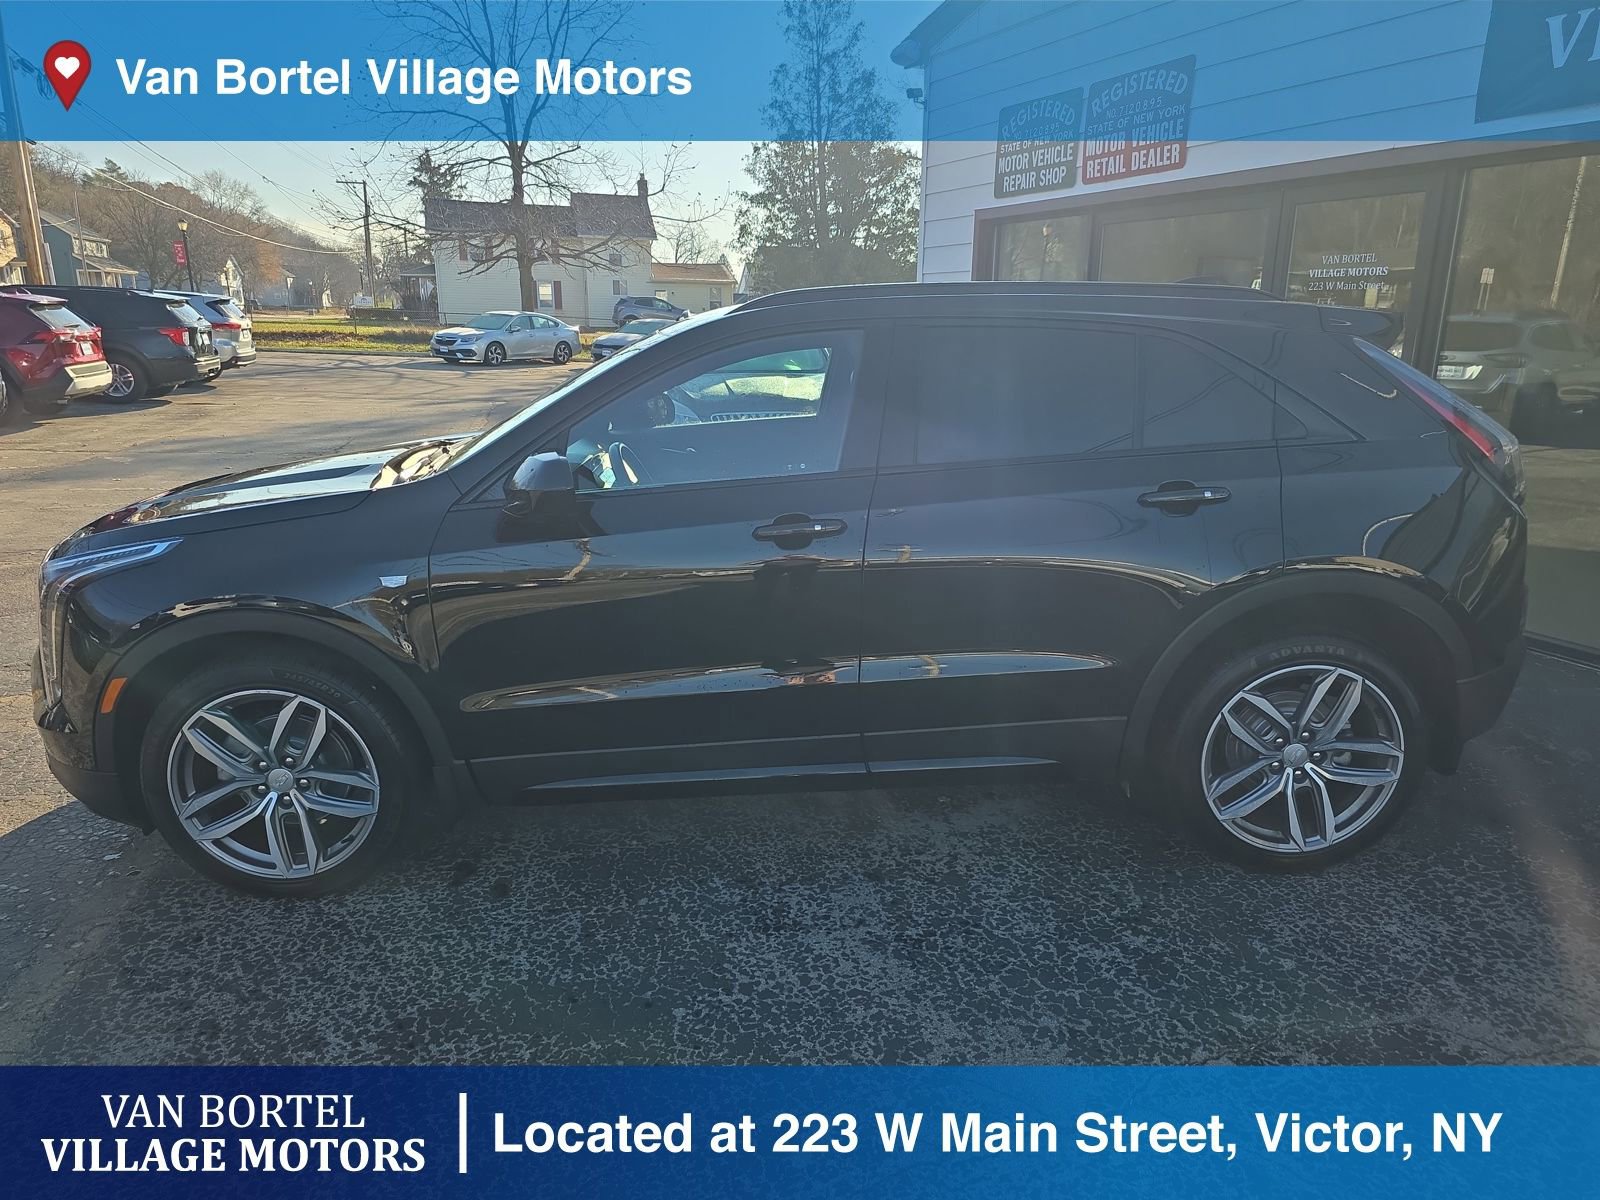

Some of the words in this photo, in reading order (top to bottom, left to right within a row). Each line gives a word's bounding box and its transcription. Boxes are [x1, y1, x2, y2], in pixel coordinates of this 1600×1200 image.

[1091, 69, 1188, 118] REGISTERED
[1001, 99, 1075, 142] REGISTERED
[1087, 120, 1114, 136] STATE
[1118, 117, 1130, 129] OF
[1133, 111, 1154, 125] NEW
[1158, 103, 1186, 120] YORK
[1000, 140, 1020, 154] STATE
[1022, 138, 1032, 149] OF
[1034, 134, 1050, 147] NEW
[1053, 130, 1074, 142] YORK
[1086, 131, 1126, 157] MOTOR
[1131, 118, 1185, 148] VEHICLE
[998, 152, 1029, 174] MOTOR
[1032, 142, 1074, 168] VEHICLE
[1087, 154, 1126, 179] RETAIL
[1131, 143, 1180, 171] DEALER
[1003, 171, 1036, 193] REPAIR
[1039, 166, 1067, 187] SHOP
[1309, 268, 1347, 278] VILLAGE
[1347, 266, 1389, 277] MOTORS
[1322, 255, 1340, 264] VAN
[1342, 253, 1377, 263] BORTEL
[1308, 282, 1323, 291] 223
[1325, 281, 1335, 290] W
[1336, 281, 1357, 290] Main
[1359, 280, 1385, 290] Street
